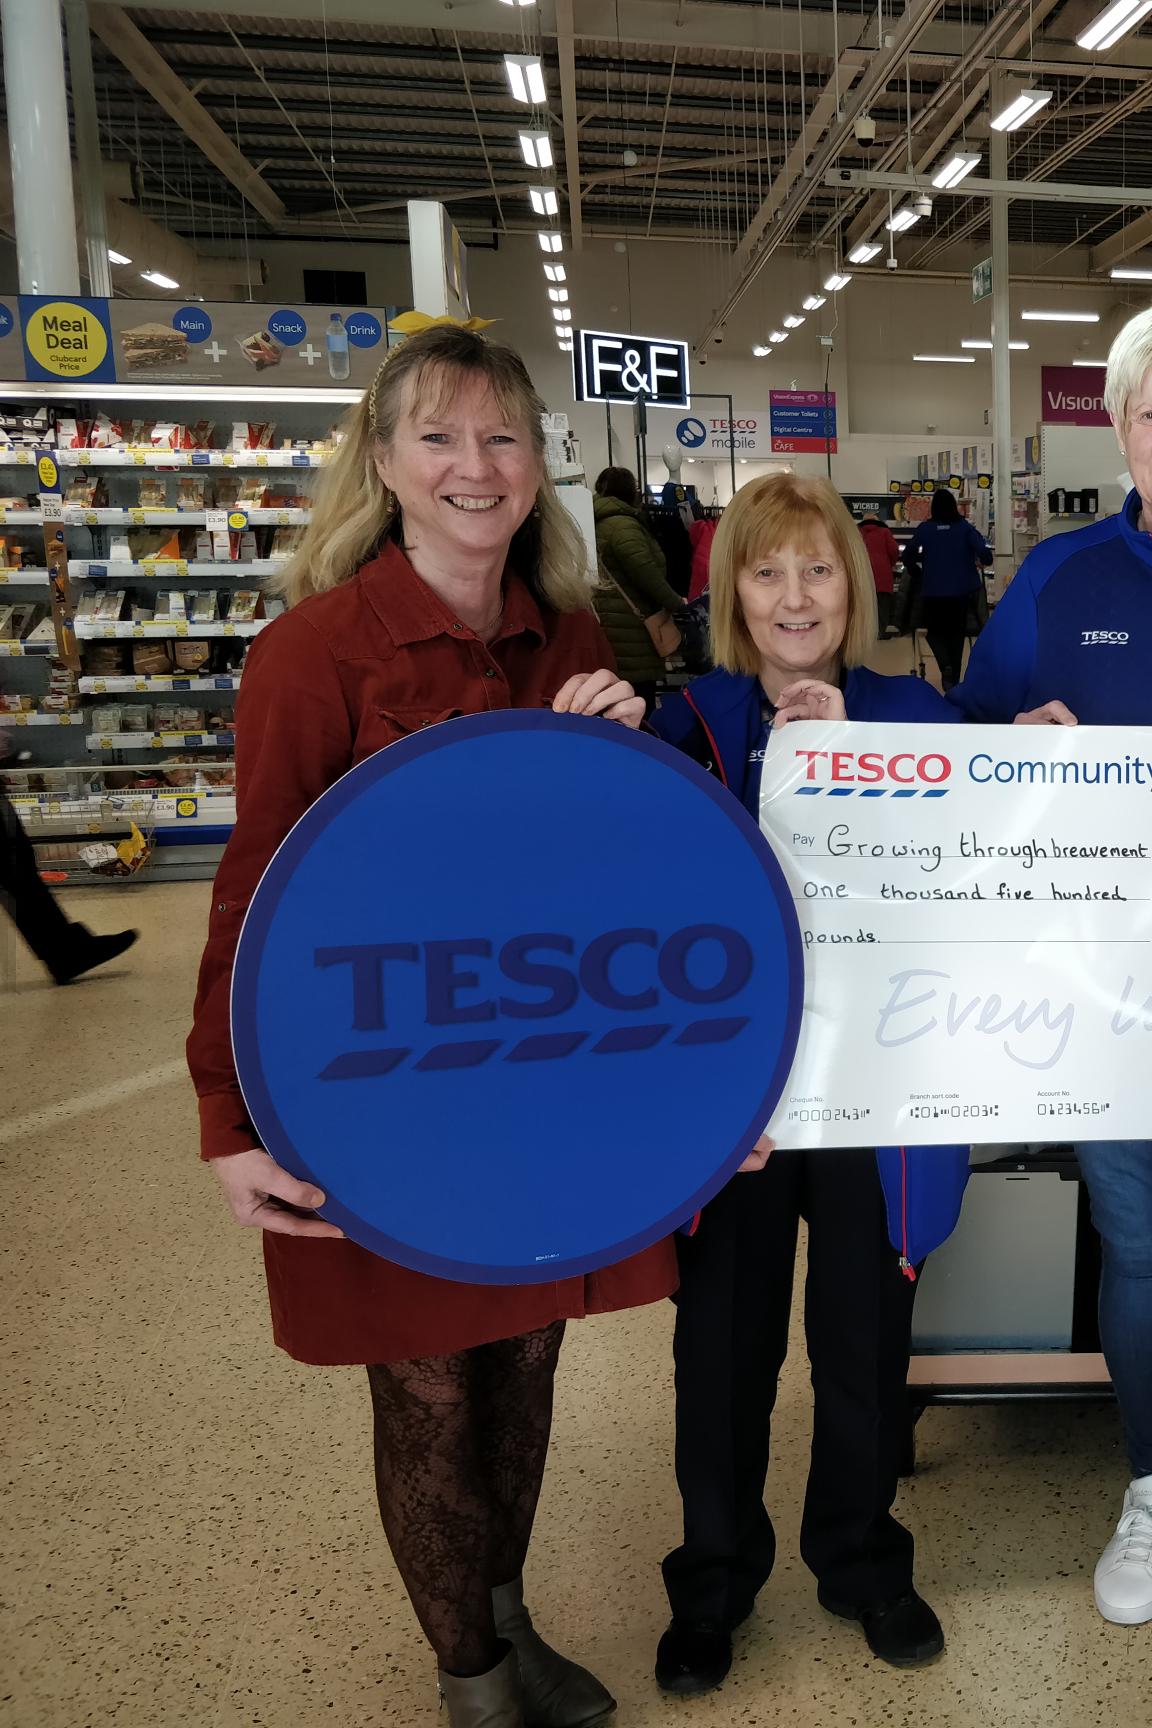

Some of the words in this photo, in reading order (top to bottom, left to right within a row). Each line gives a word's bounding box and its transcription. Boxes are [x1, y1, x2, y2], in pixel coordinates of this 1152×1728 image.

[42, 316, 88, 333] Meal
[180, 320, 205, 330] Main
[272, 323, 303, 333] Snack
[350, 325, 376, 335] Drink
[46, 334, 88, 350] Deal
[50, 355, 87, 363] Clubcard
[59, 363, 80, 371] Price
[592, 339, 678, 399] F&F
[710, 419, 757, 429] TESCO
[711, 437, 756, 449] mobile
[1081, 630, 1129, 641] TESCO
[794, 749, 952, 785] TESCO
[792, 833, 816, 847] Pay
[826, 823, 943, 873] Growing
[959, 832, 1048, 869] through
[803, 881, 849, 899] One
[880, 883, 986, 901] thousand
[995, 884, 1034, 901] five
[1051, 885, 1128, 902] hundred
[313, 922, 755, 1032] TESCO
[875, 968, 1075, 1071] Every
